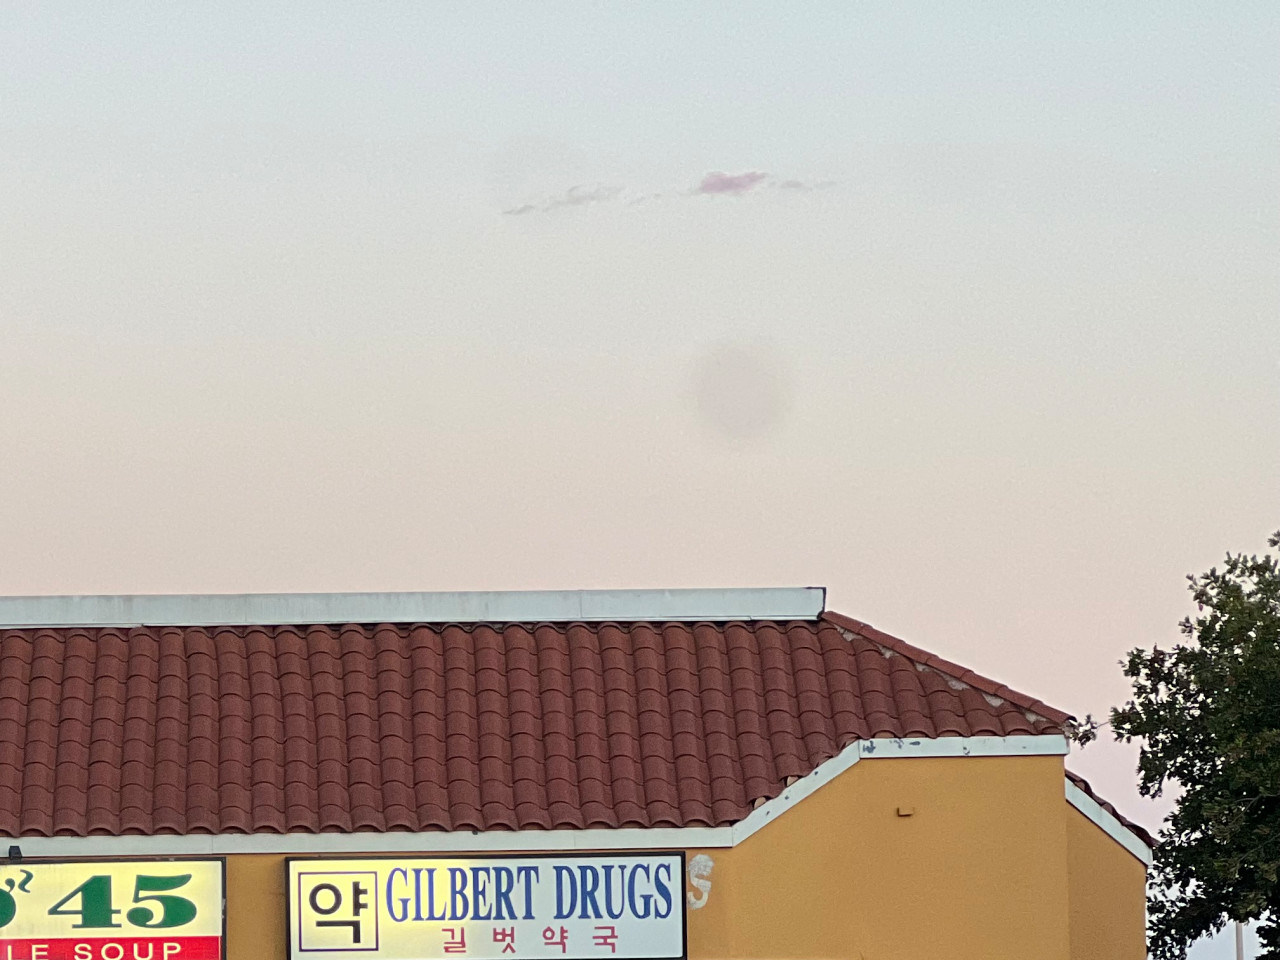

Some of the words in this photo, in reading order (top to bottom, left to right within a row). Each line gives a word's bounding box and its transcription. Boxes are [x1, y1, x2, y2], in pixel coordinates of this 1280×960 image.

[47, 873, 198, 929] 45
[309, 881, 368, 944] 약
[386, 866, 539, 923] GILBERT
[553, 863, 673, 921] DRUGS
